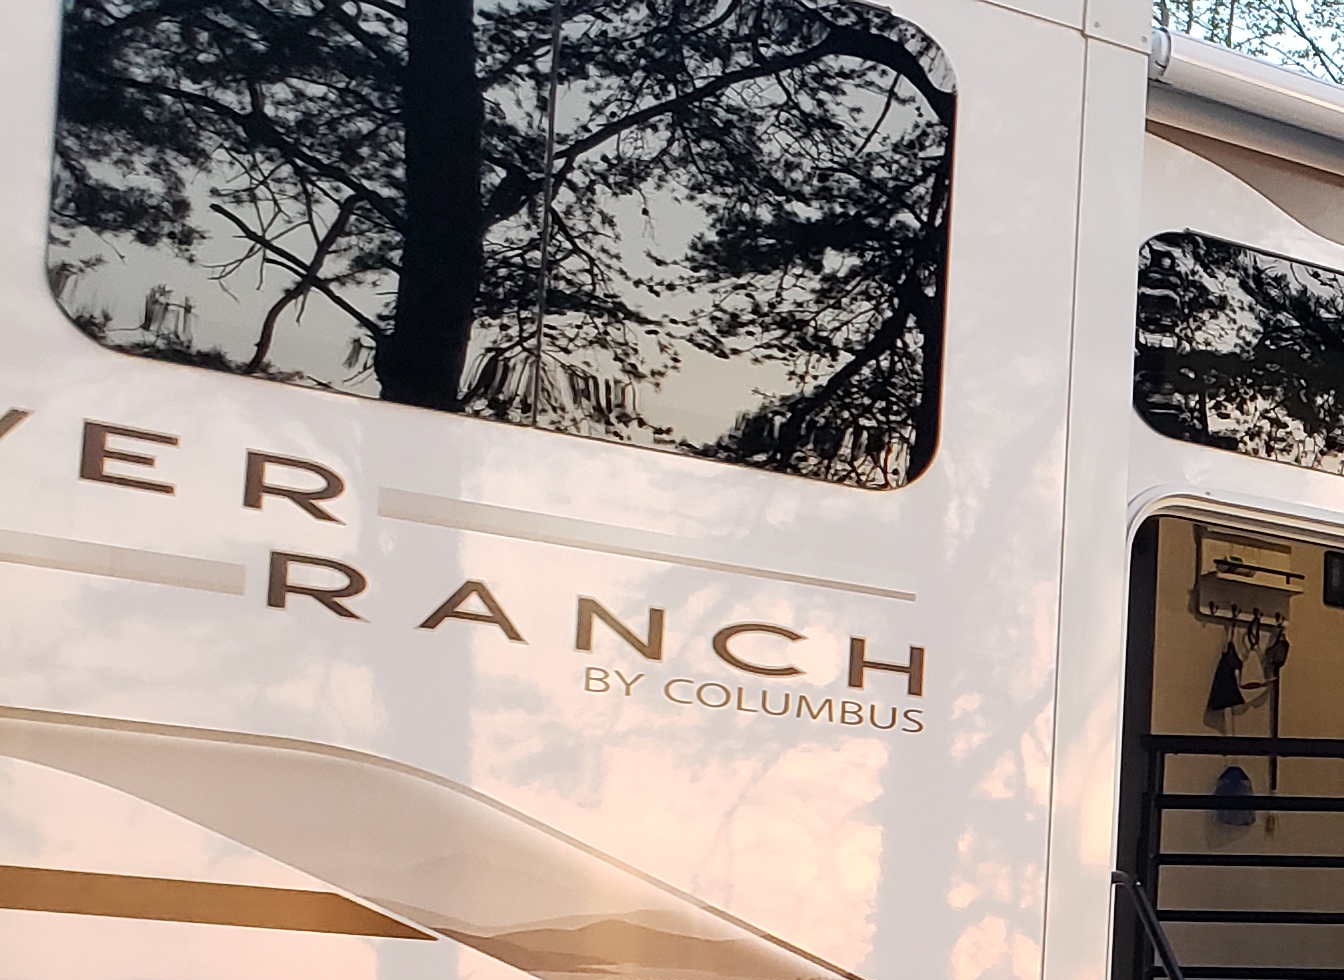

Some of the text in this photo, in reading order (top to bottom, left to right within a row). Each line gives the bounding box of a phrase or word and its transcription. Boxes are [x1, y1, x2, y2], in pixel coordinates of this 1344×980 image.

[266, 550, 926, 698] RANCH
[584, 666, 924, 733] BY COLUMBUS
